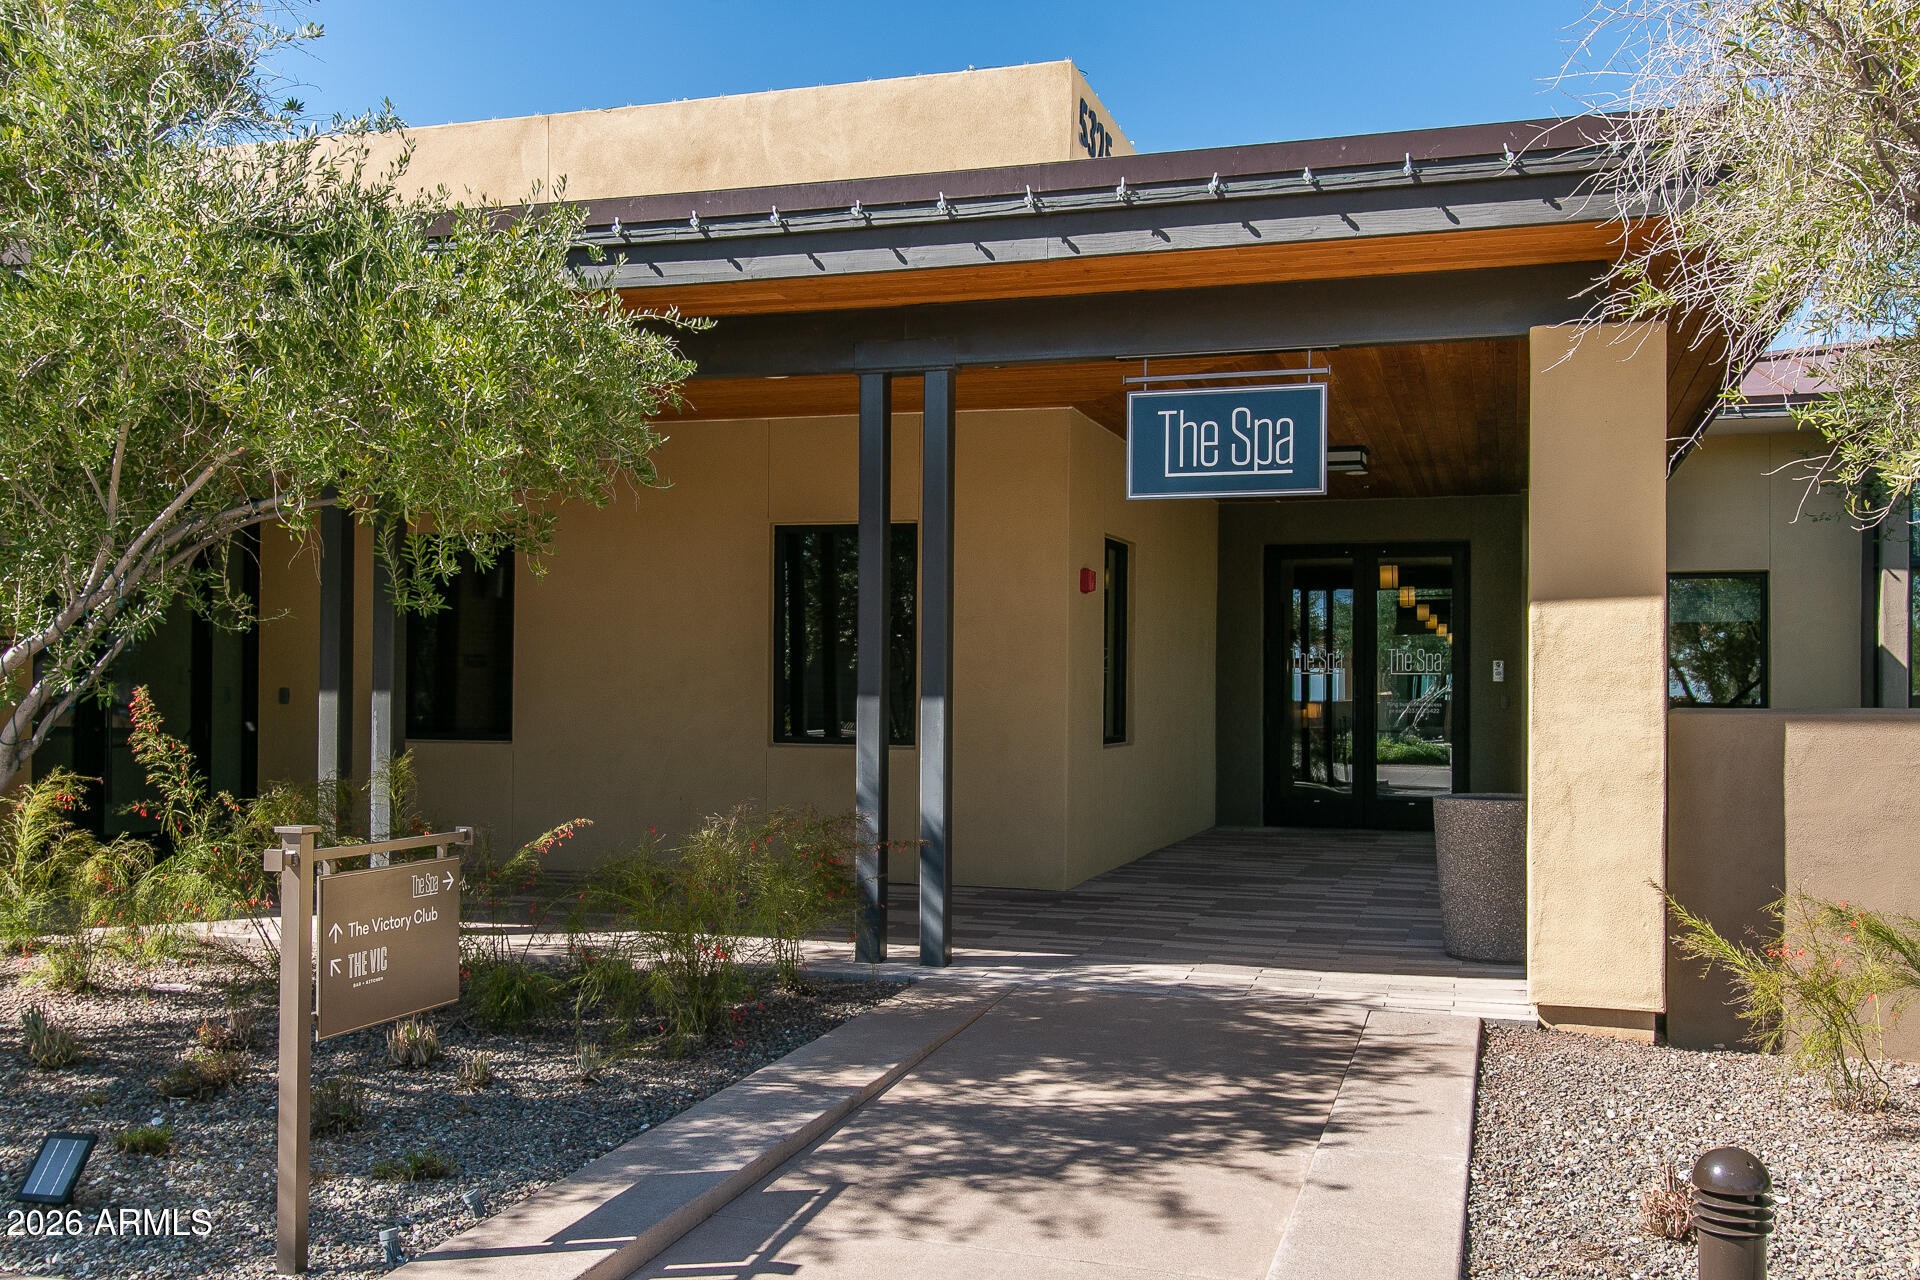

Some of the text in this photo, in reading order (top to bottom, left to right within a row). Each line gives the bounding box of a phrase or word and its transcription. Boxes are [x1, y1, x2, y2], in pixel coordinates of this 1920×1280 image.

[1157, 406, 1294, 477] The Spa
[1318, 647, 1343, 674] Spa
[1387, 648, 1442, 675] The Spa
[411, 872, 438, 898] The Spa
[348, 906, 438, 937] The Victory Club
[348, 946, 388, 979] THE VIC
